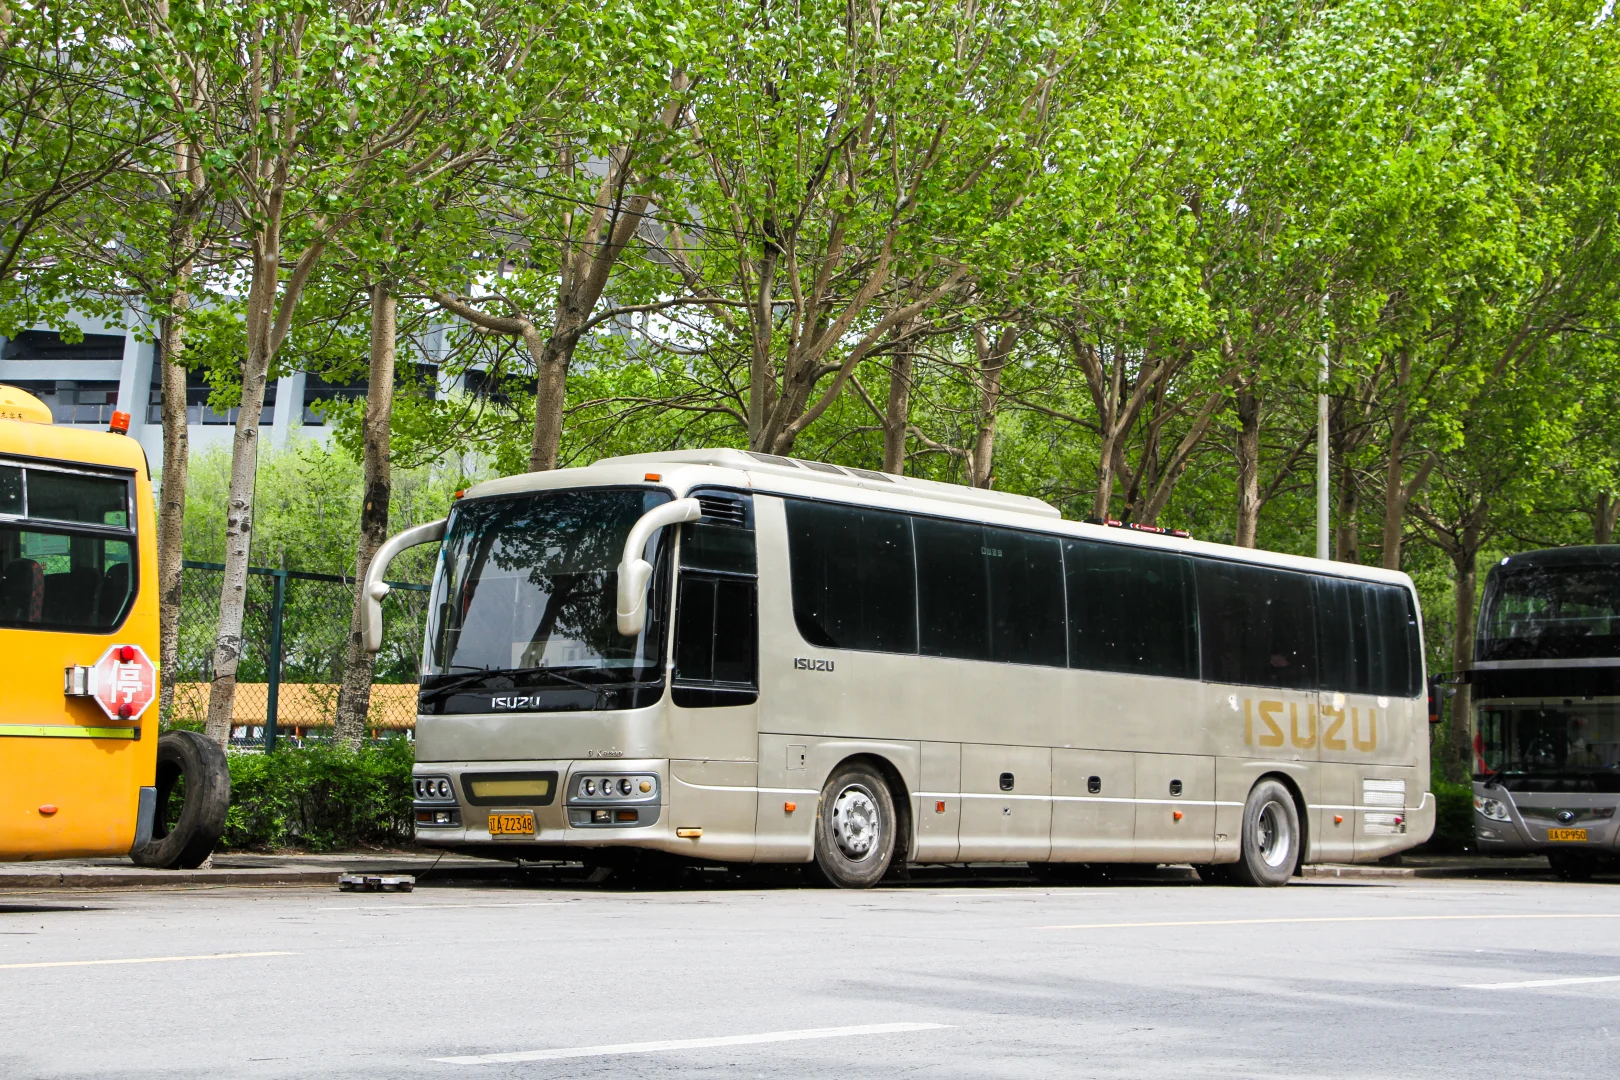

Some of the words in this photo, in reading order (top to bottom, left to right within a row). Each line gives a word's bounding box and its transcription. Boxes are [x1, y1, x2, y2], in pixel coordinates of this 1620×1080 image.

[793, 657, 835, 672] ISUZU
[108, 659, 143, 704] 停
[491, 696, 541, 709] ISUZU
[1243, 698, 1377, 752] ISUZU
